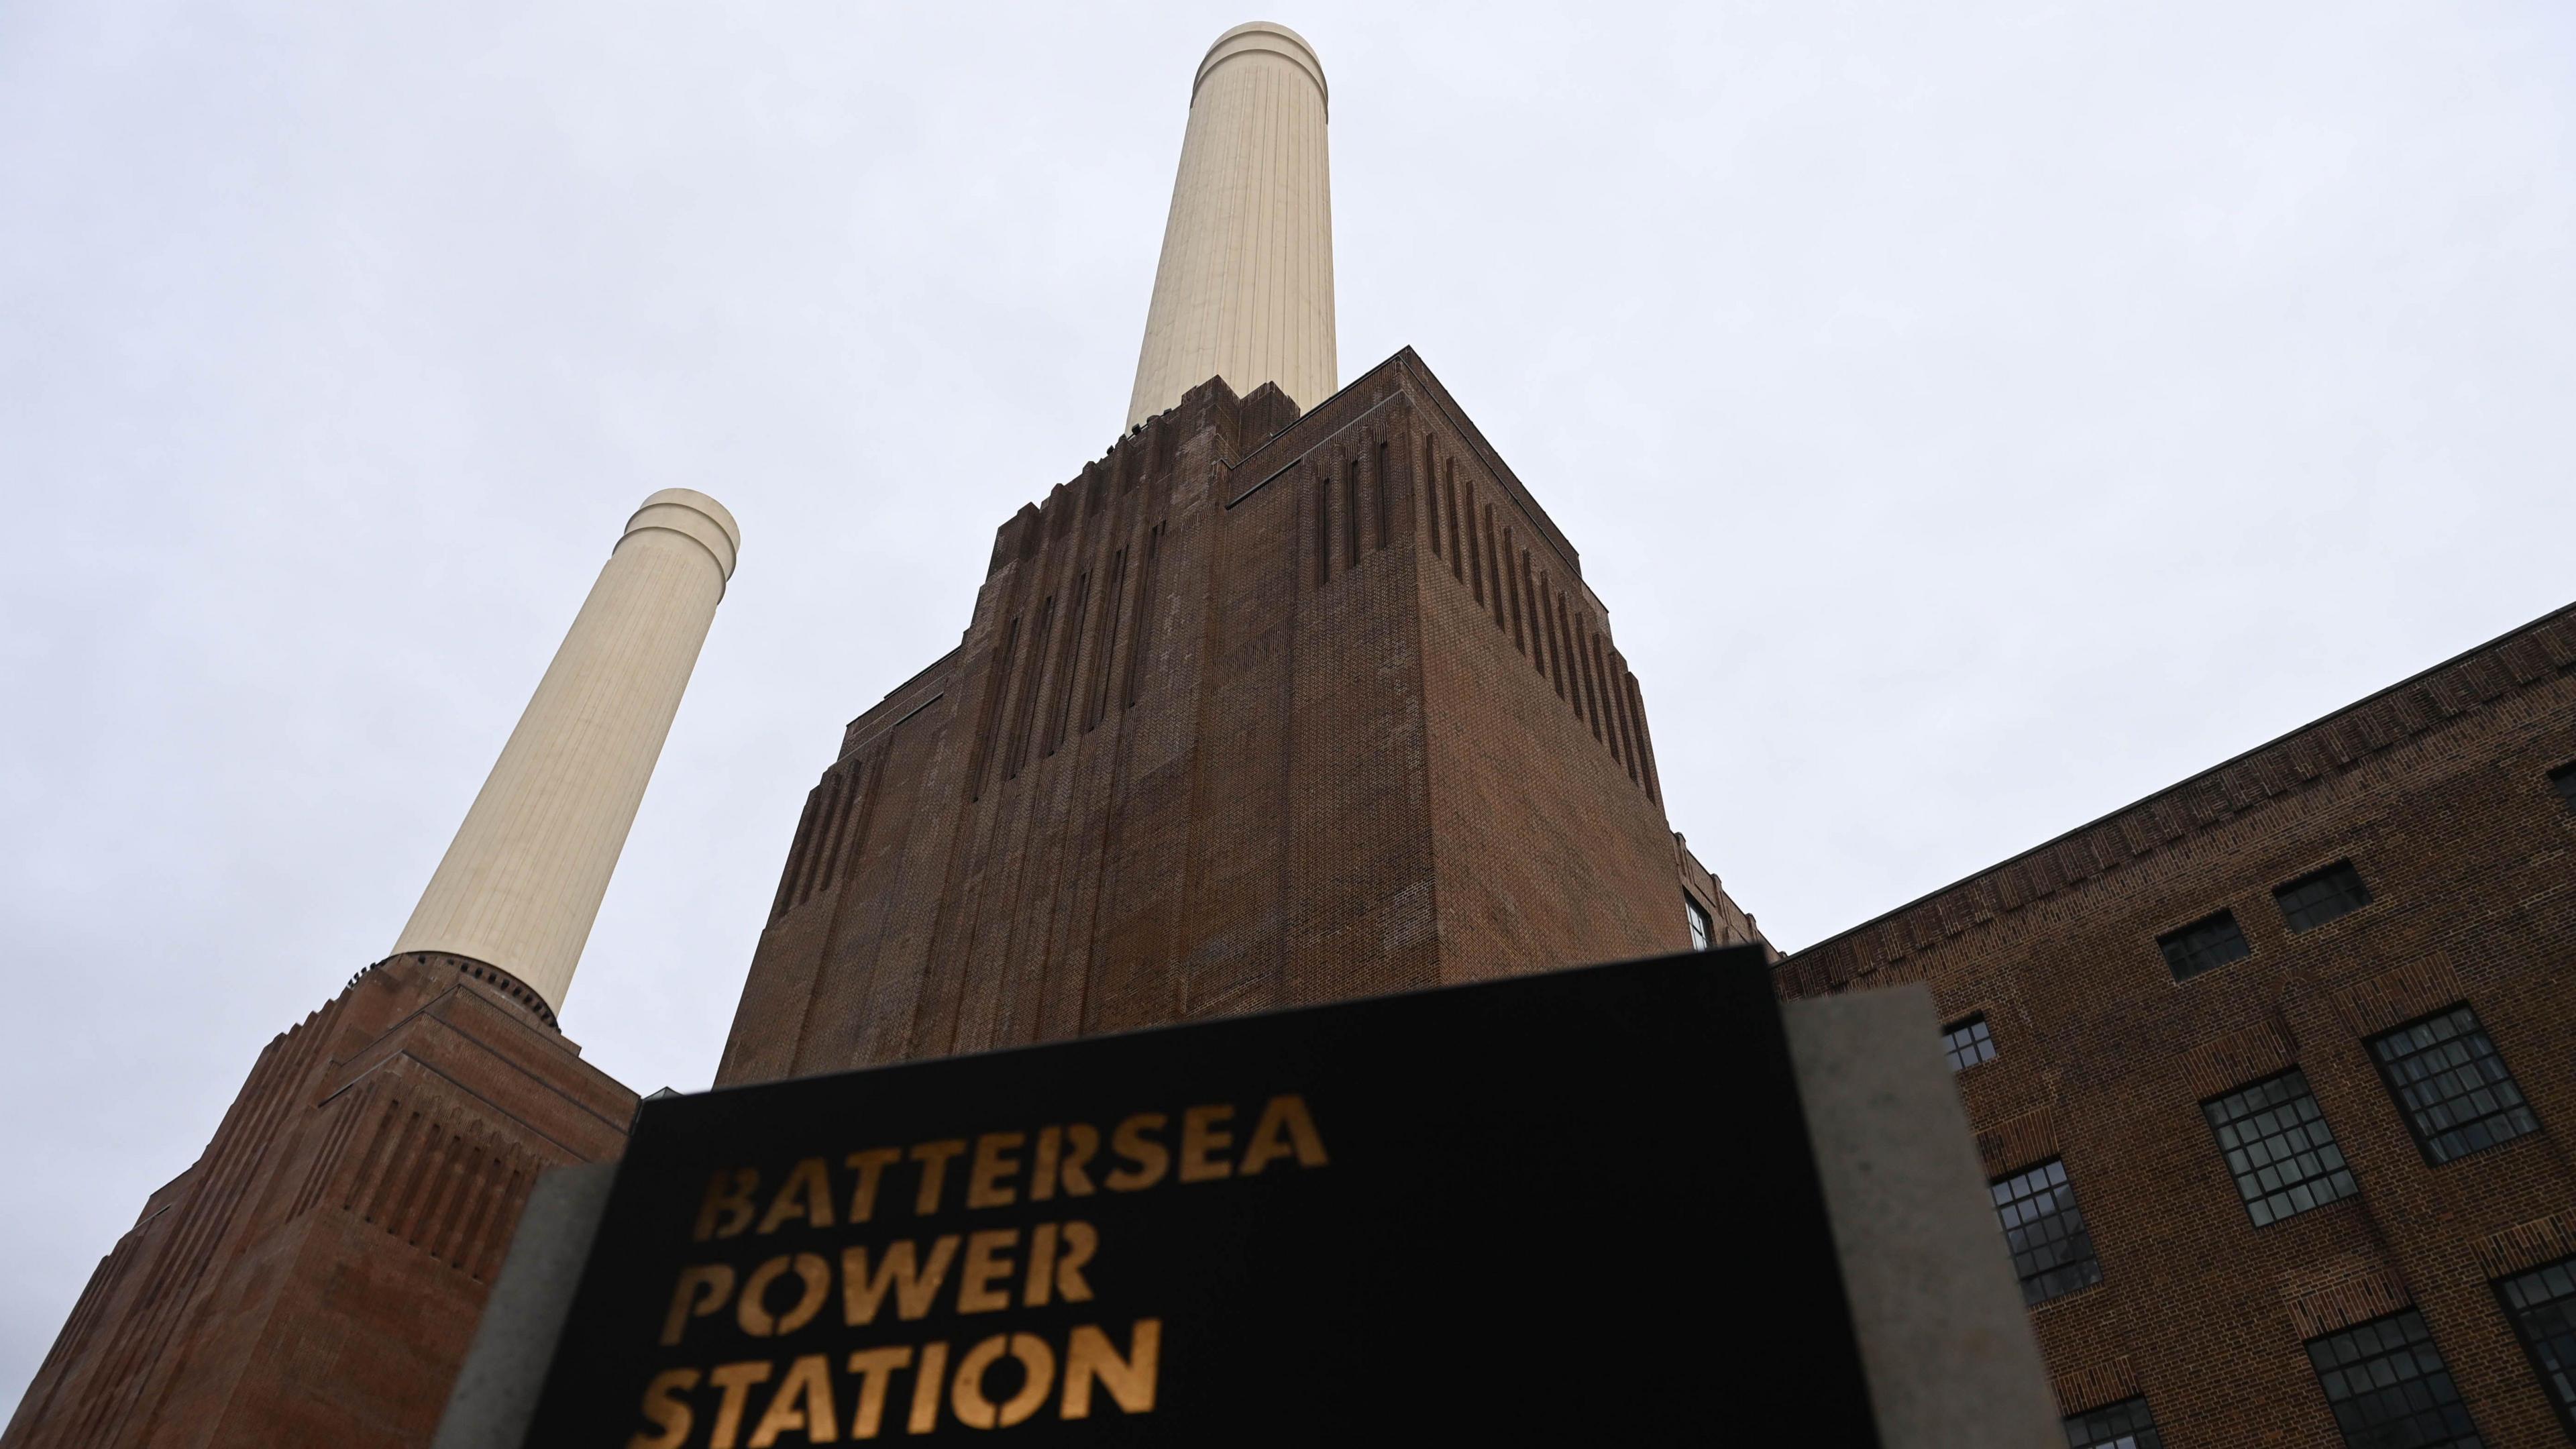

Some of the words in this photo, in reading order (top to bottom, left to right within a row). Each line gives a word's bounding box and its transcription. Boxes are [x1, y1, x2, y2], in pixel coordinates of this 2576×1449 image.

[692, 1095, 1330, 1242] BATTERSEA
[660, 1220, 1099, 1346] POWER
[628, 1318, 1163, 1449] STATION
